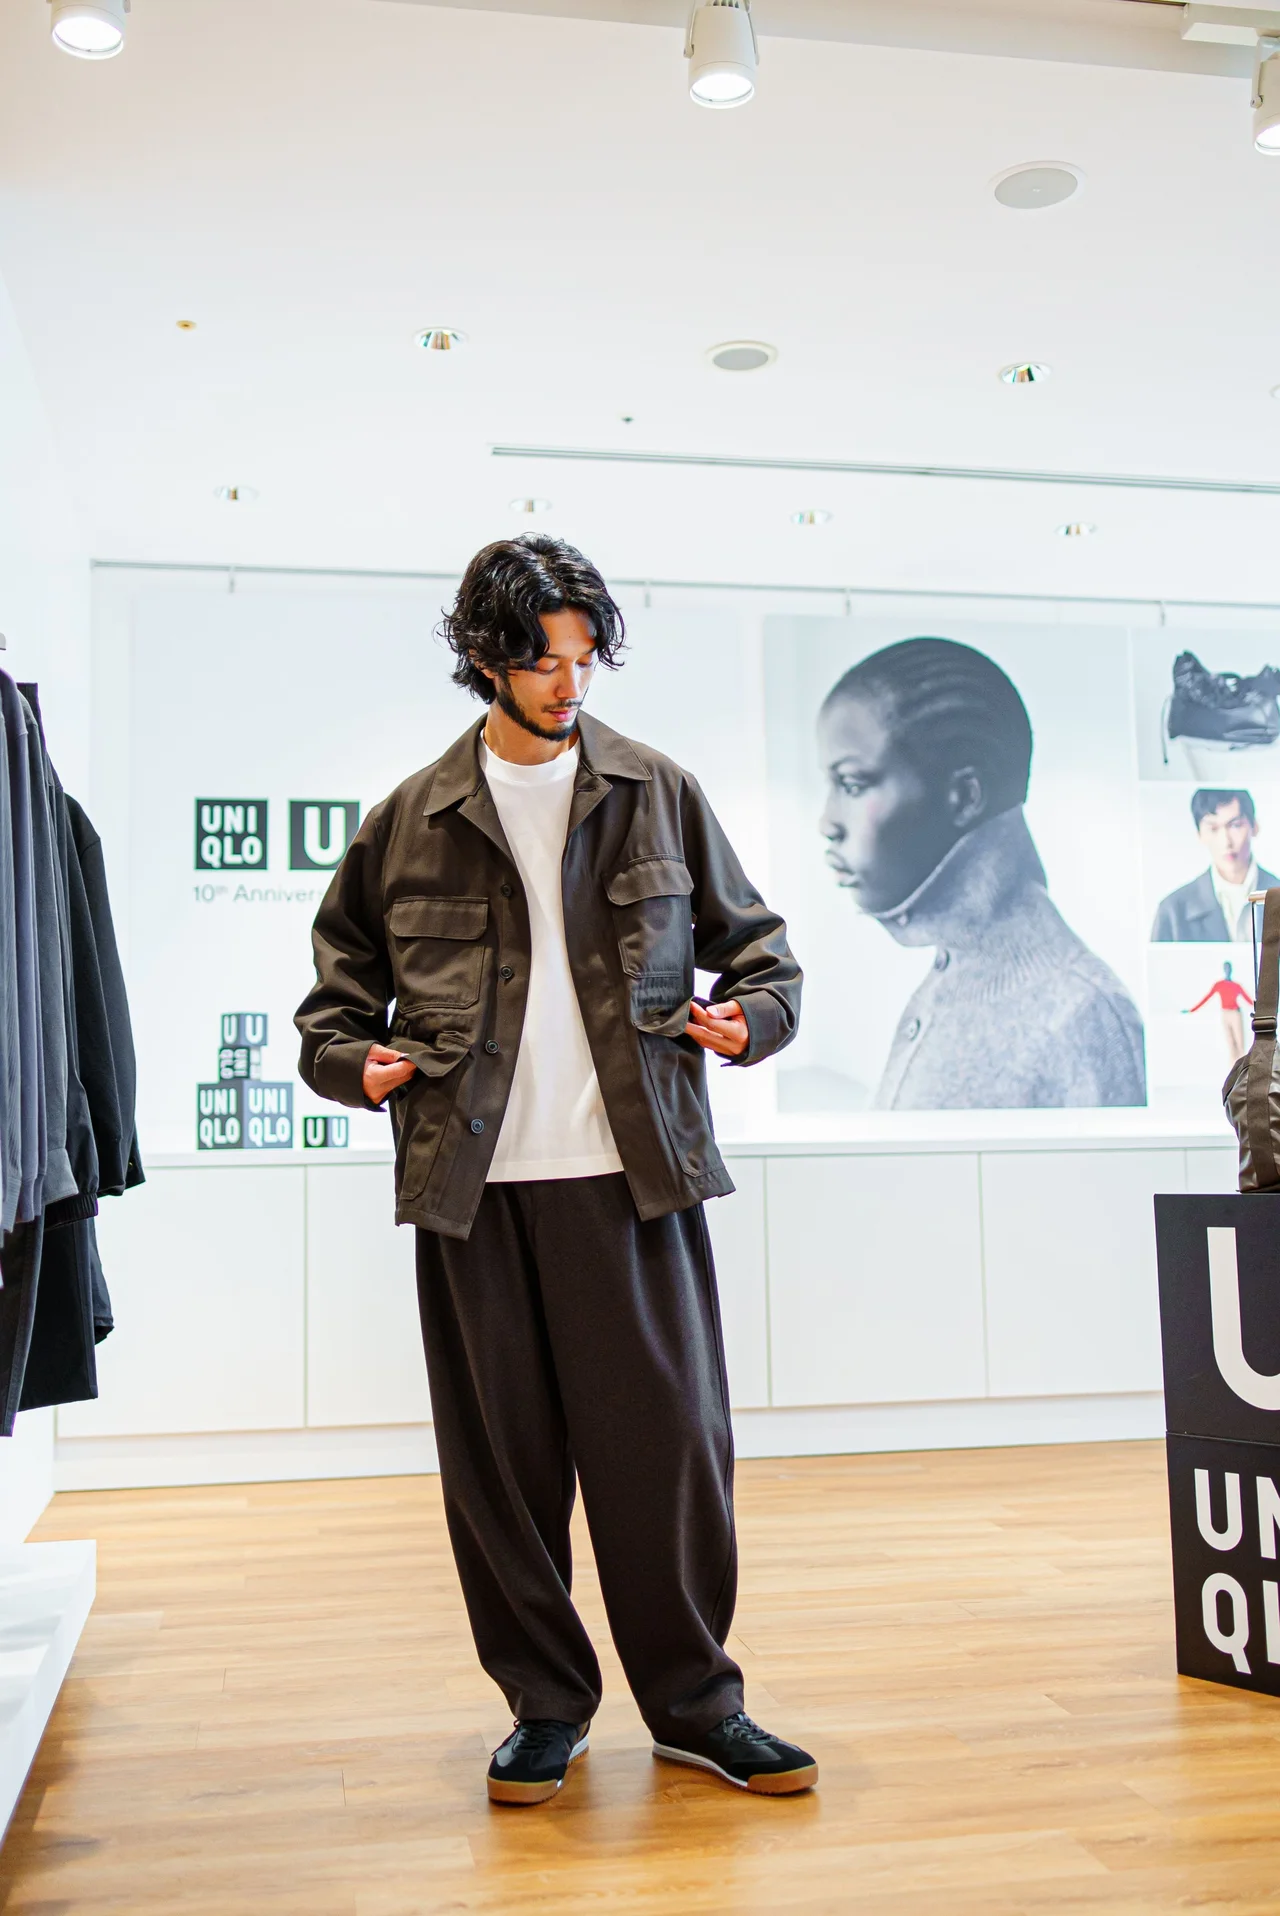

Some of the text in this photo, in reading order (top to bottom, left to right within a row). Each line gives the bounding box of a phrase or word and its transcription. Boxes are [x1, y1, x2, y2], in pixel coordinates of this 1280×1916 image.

[201, 805, 257, 834] UNI
[304, 806, 346, 866] U
[201, 836, 263, 868] QLO
[223, 1015, 237, 1044] U
[245, 1014, 263, 1044] U
[200, 1088, 237, 1115] UNI
[249, 1088, 287, 1114] UNI
[200, 1117, 240, 1148] QLO
[249, 1116, 290, 1147] QLO
[306, 1118, 325, 1146] U
[332, 1118, 347, 1146] U
